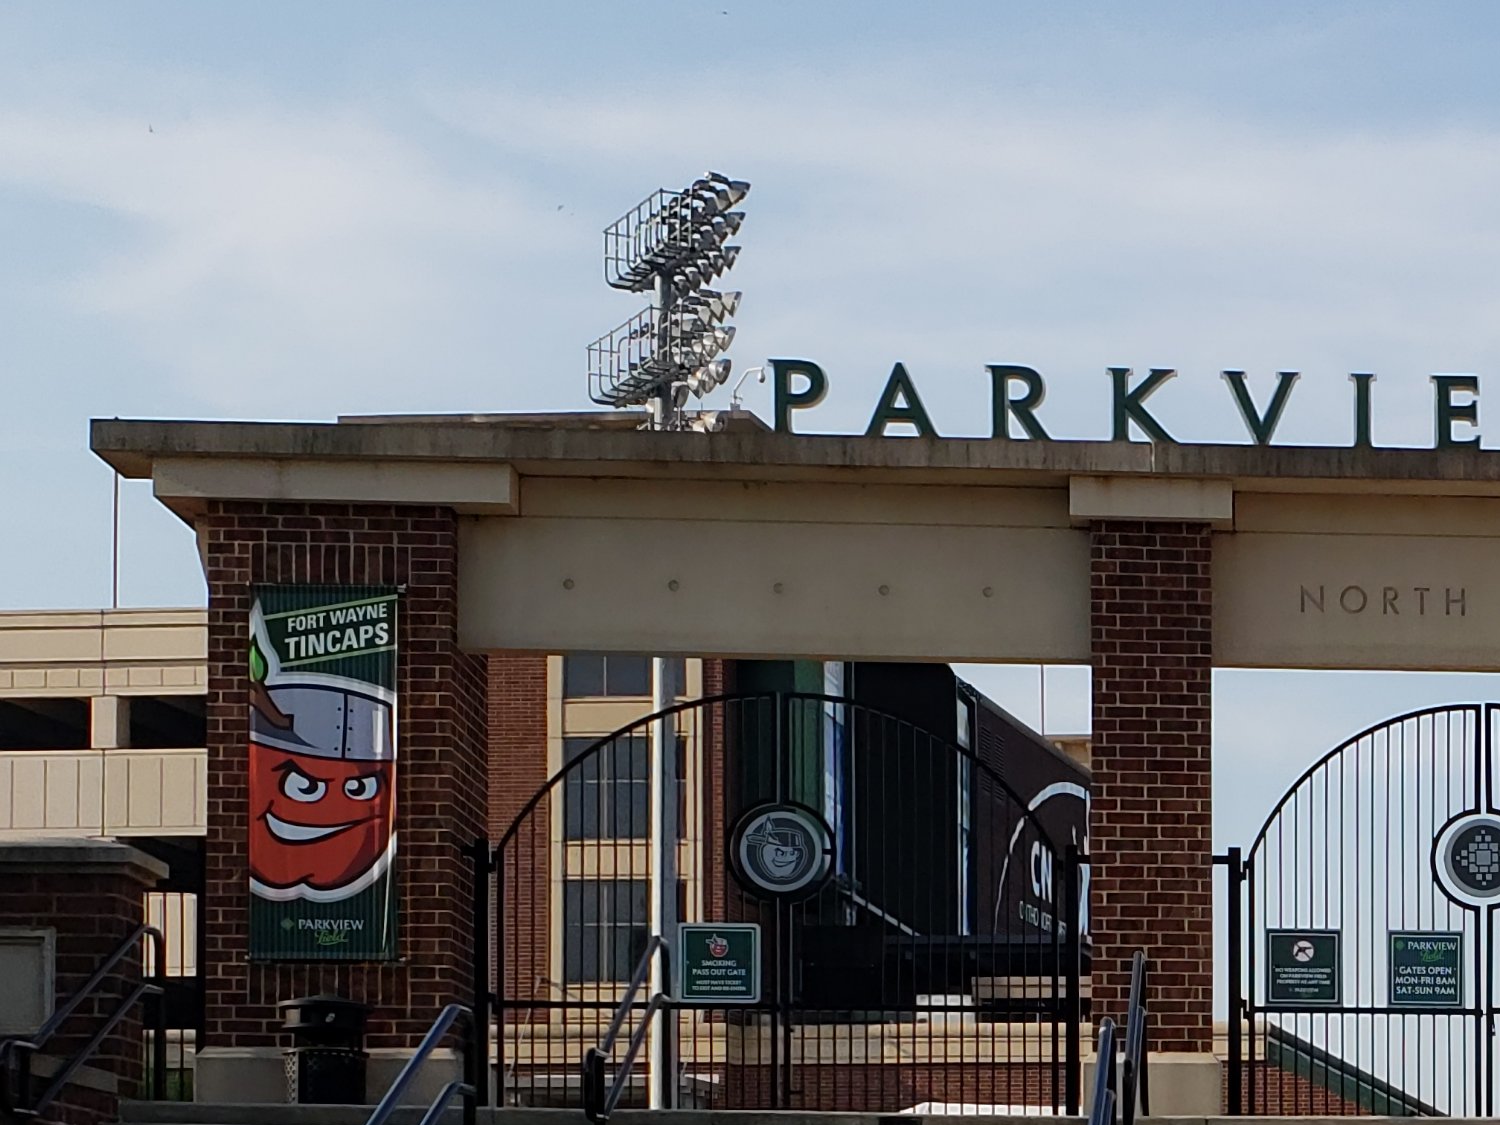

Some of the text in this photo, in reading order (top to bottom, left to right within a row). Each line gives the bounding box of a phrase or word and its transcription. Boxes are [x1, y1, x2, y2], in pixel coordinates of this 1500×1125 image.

[1299, 584, 1468, 617] NORTH
[287, 603, 387, 632] FORT WAYNE
[284, 622, 389, 659] TINCAPS
[298, 919, 364, 930] PARKVIEW
[314, 929, 349, 945] Field
[1407, 941, 1457, 951] PARKVIEW
[701, 959, 737, 967] SMOKING
[692, 968, 746, 976] PASS OUT GATE
[1399, 966, 1452, 975] GATES OPEN
[1395, 976, 1456, 985] MON-FRI 8AM
[1396, 986, 1455, 995] SAT-SUN 9AM
